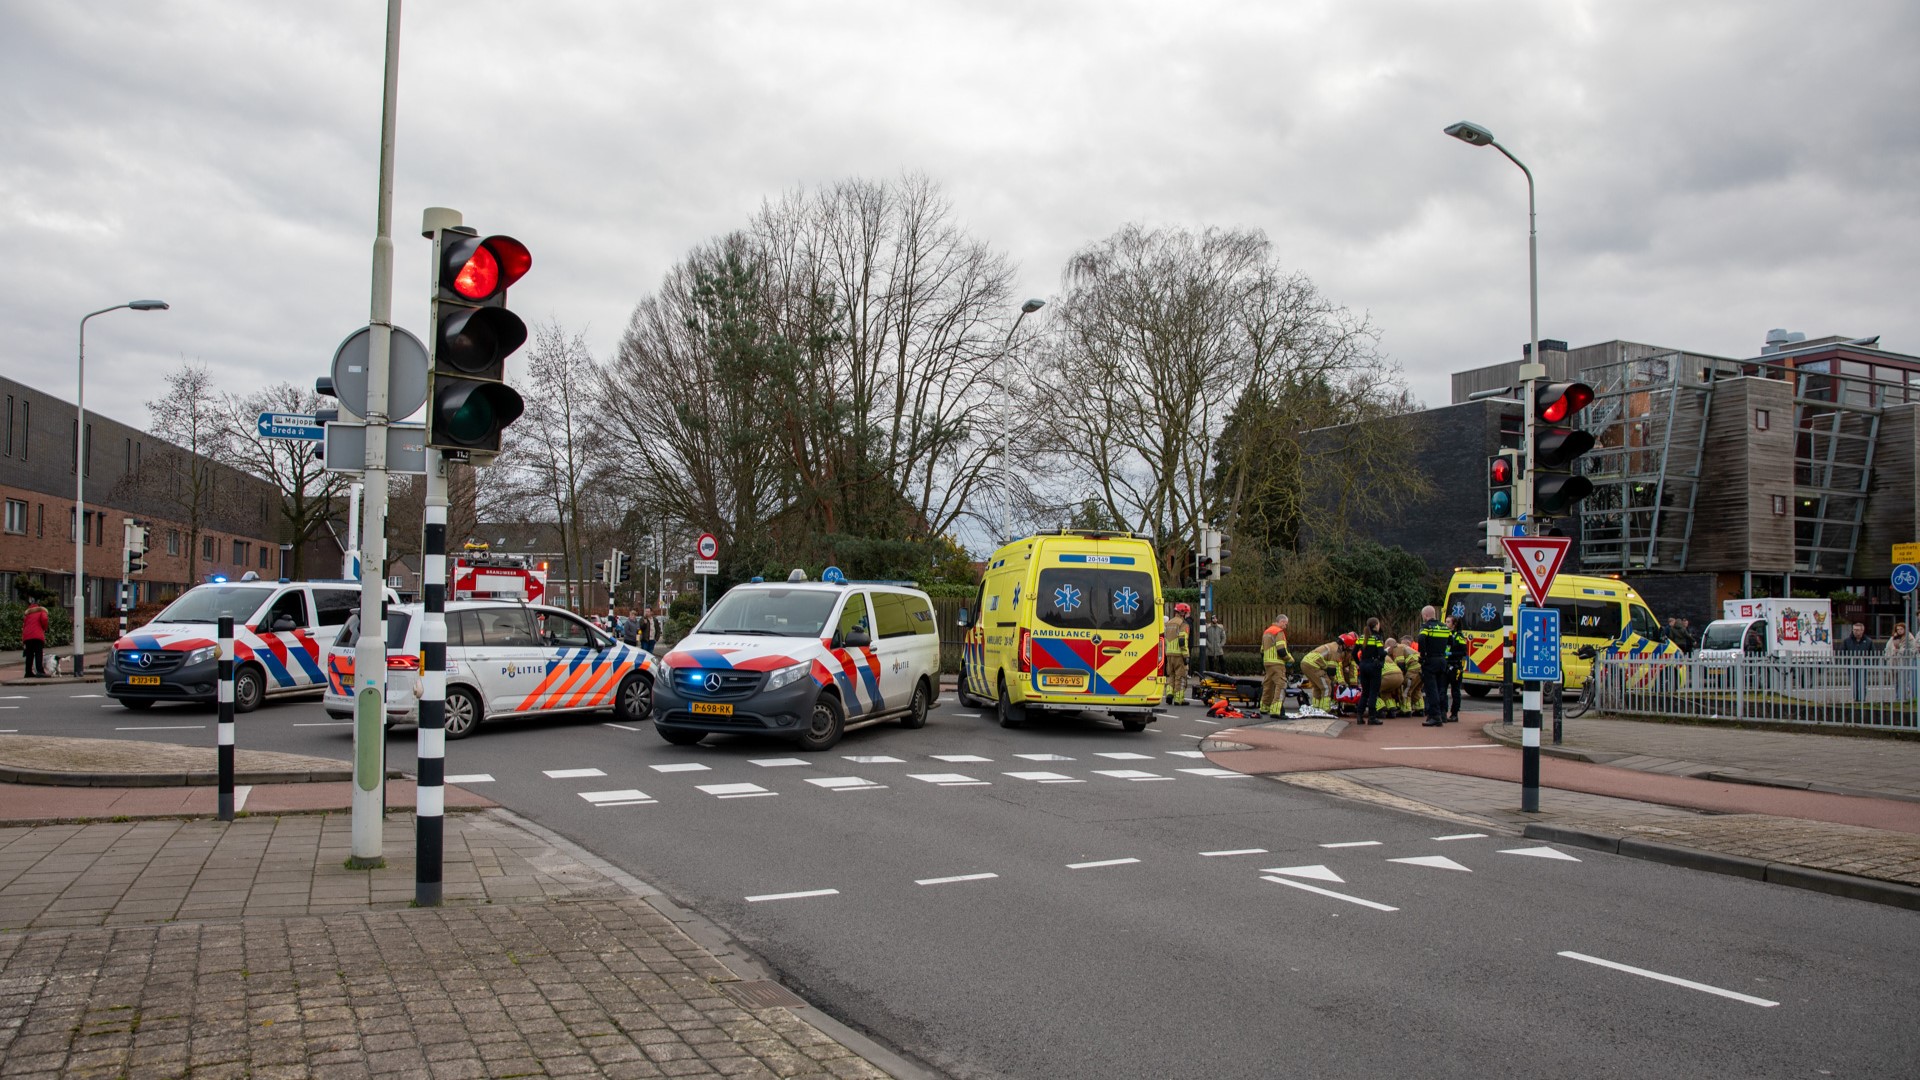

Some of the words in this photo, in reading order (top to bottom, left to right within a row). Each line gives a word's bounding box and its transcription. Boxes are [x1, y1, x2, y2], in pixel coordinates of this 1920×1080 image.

[271, 427, 297, 435] Breda
[1785, 621, 1797, 630] PIC
[1033, 629, 1091, 638] AMBULANCE
[1785, 629, 1797, 638] NIC
[502, 664, 543, 678] POLITIE
[1522, 666, 1540, 675] LET
[1543, 666, 1556, 675] OP
[1048, 677, 1081, 685] L-396-VS
[694, 703, 731, 714] P-698-RK
